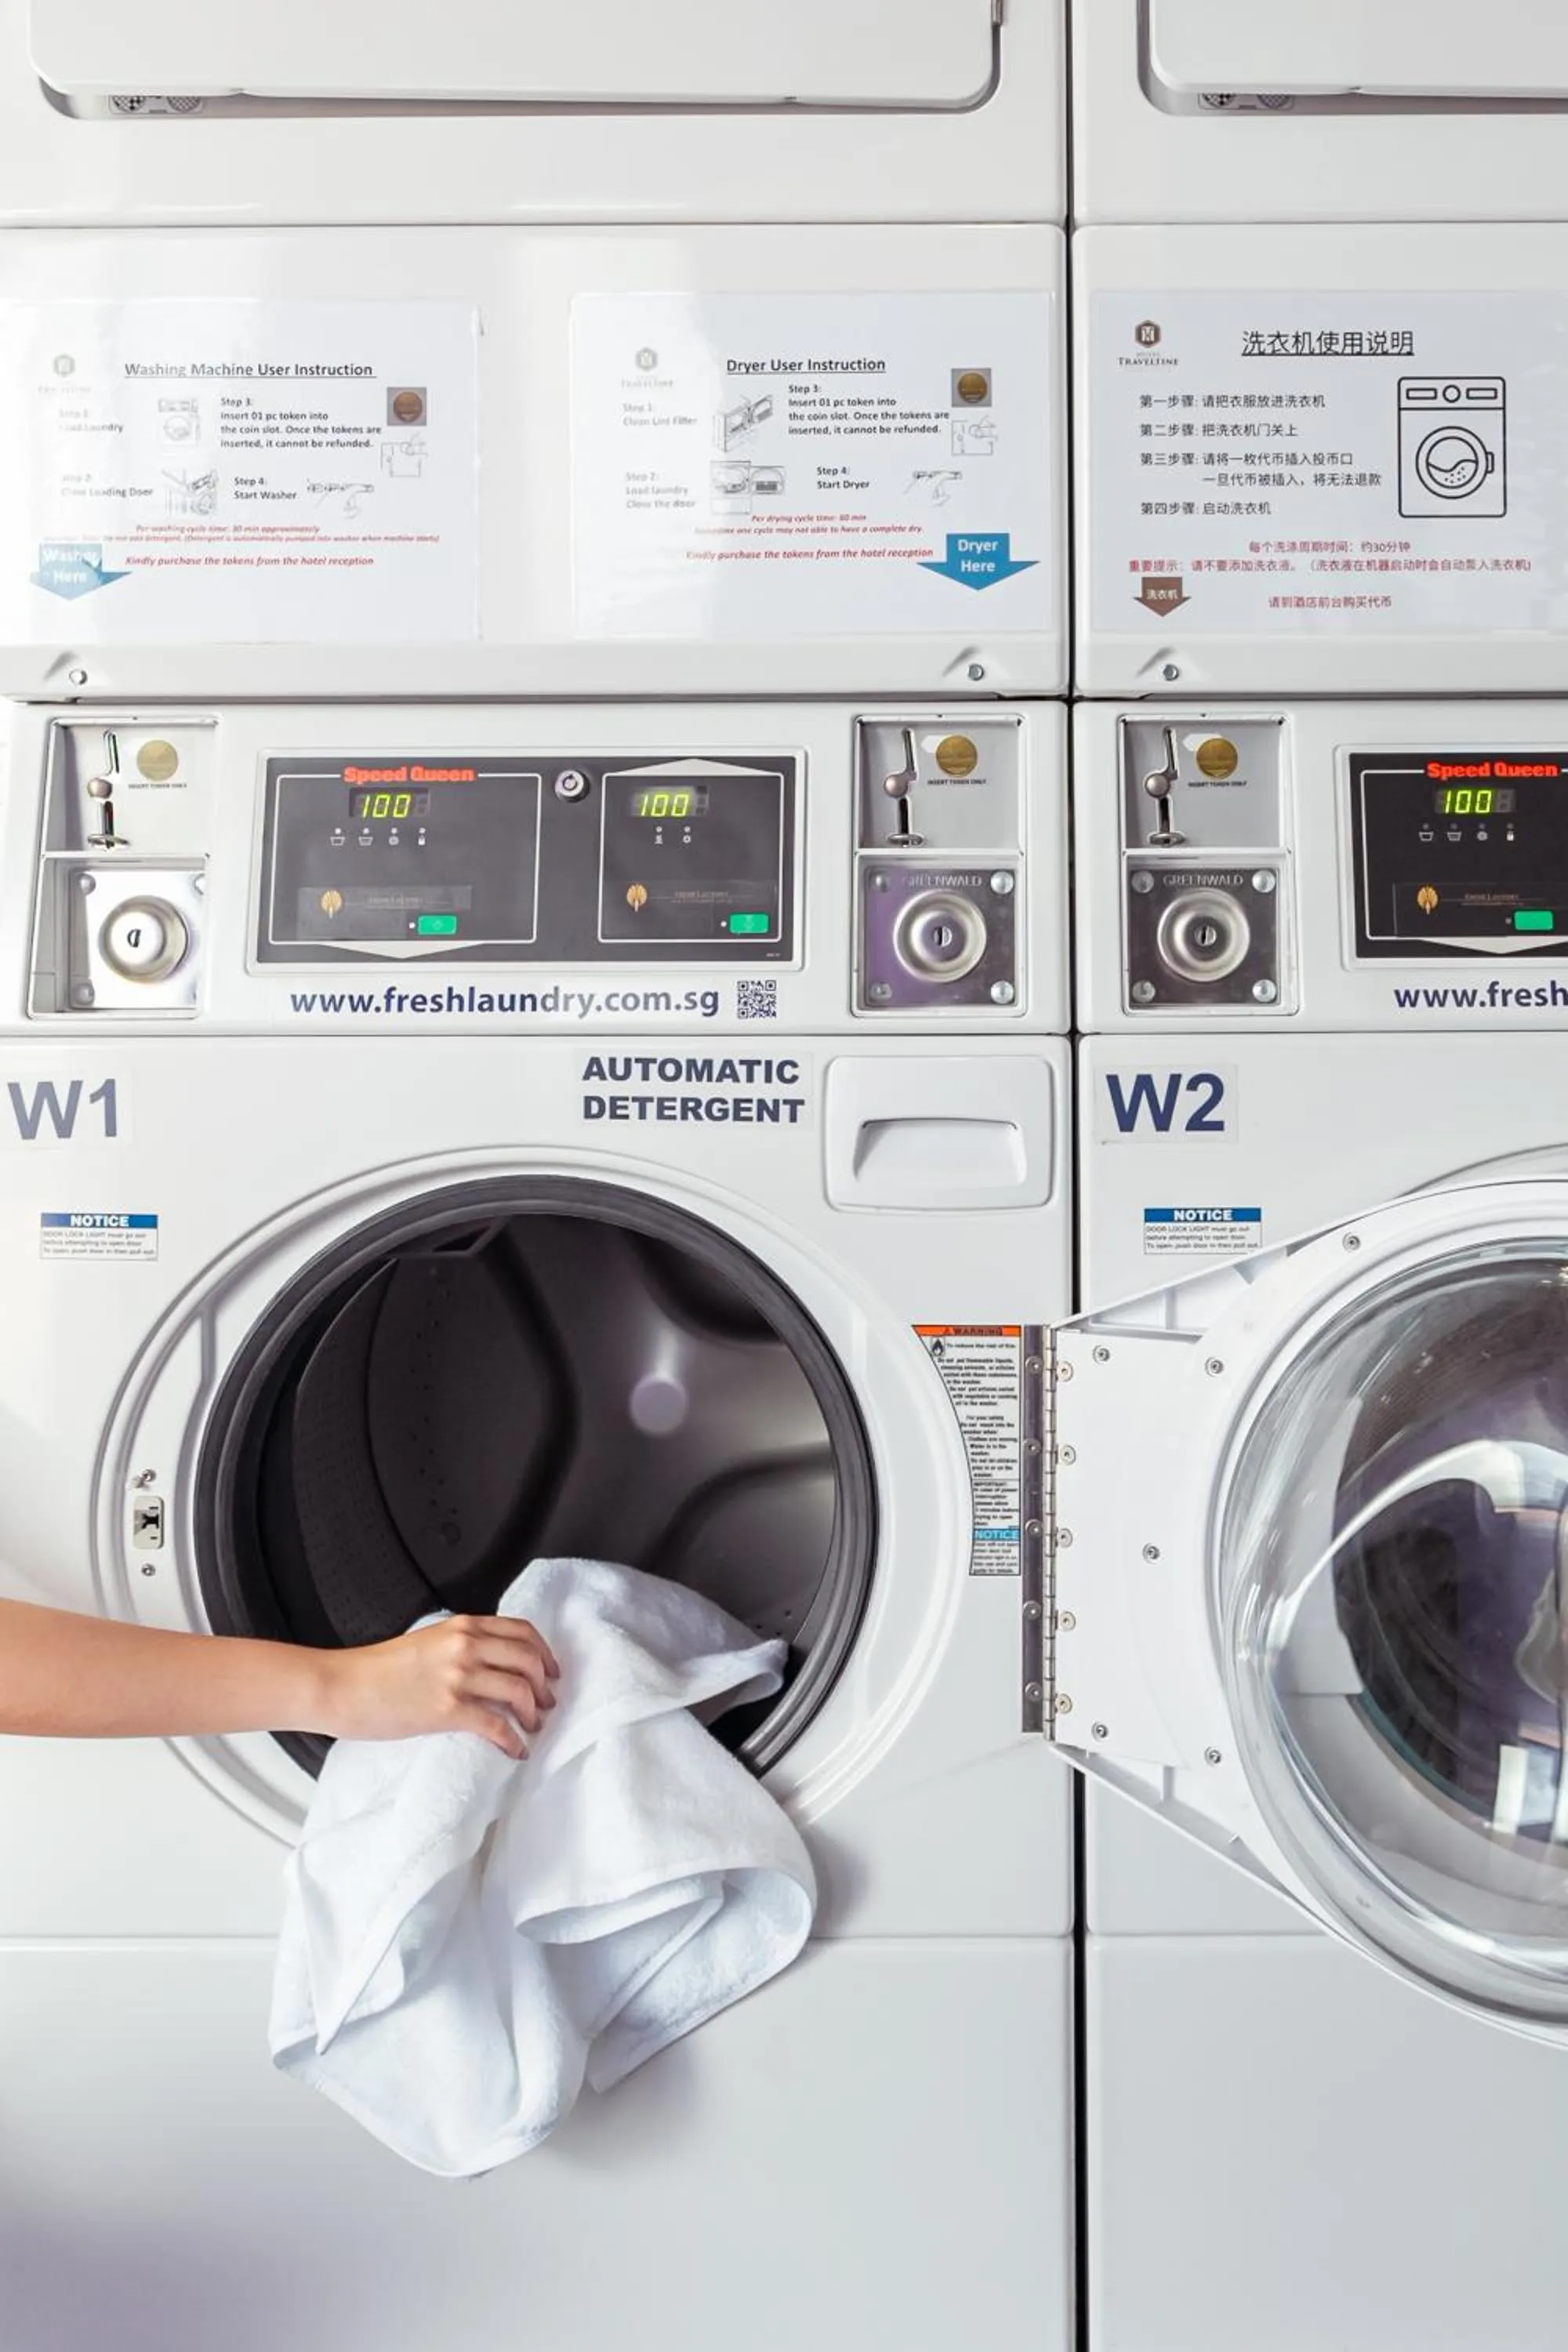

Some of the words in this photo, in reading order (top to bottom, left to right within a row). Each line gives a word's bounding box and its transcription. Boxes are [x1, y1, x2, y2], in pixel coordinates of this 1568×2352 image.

[1242, 330, 1414, 354] 洗衣机使用说明
[125, 364, 186, 376] Washing
[191, 364, 253, 376] Machine
[259, 364, 290, 376] User
[296, 364, 372, 376] Instruction
[728, 360, 766, 372] Dryer
[771, 360, 803, 371] User
[808, 358, 885, 372] Instruction
[848, 397, 874, 406] token
[789, 412, 804, 421] the
[830, 412, 850, 420] slot.
[854, 412, 878, 420] Once
[789, 426, 831, 435] inserted,
[834, 426, 841, 434] it
[880, 425, 891, 434] be
[818, 481, 840, 489] Start
[844, 481, 869, 489] Dryer
[958, 539, 999, 555] Dryer
[125, 557, 156, 566] Kindly
[158, 557, 201, 566] purchase
[256, 557, 280, 567] from
[328, 557, 373, 566] reception
[687, 551, 716, 561] Kindly
[717, 550, 761, 561] purchase
[816, 550, 839, 559] from
[861, 549, 886, 557] hotel
[887, 550, 933, 558] reception
[961, 561, 995, 572] Here
[343, 766, 407, 784] Speed
[410, 765, 477, 782] Queen
[1427, 761, 1491, 780] Speed
[1494, 760, 1560, 778] Queen
[362, 794, 412, 818] 100
[641, 794, 690, 817] 100
[1445, 789, 1492, 814] 100
[1163, 874, 1243, 887] GREENWALD
[290, 986, 720, 1018] www.freshlaundry.com.sg
[583, 1057, 799, 1083] AUTOMATIC
[7, 1078, 117, 1140] W1
[584, 1096, 804, 1123] DETERGENT
[1105, 1073, 1225, 1132] W2
[71, 1215, 129, 1227] NOTICE
[1174, 1210, 1233, 1221] NOTICE
